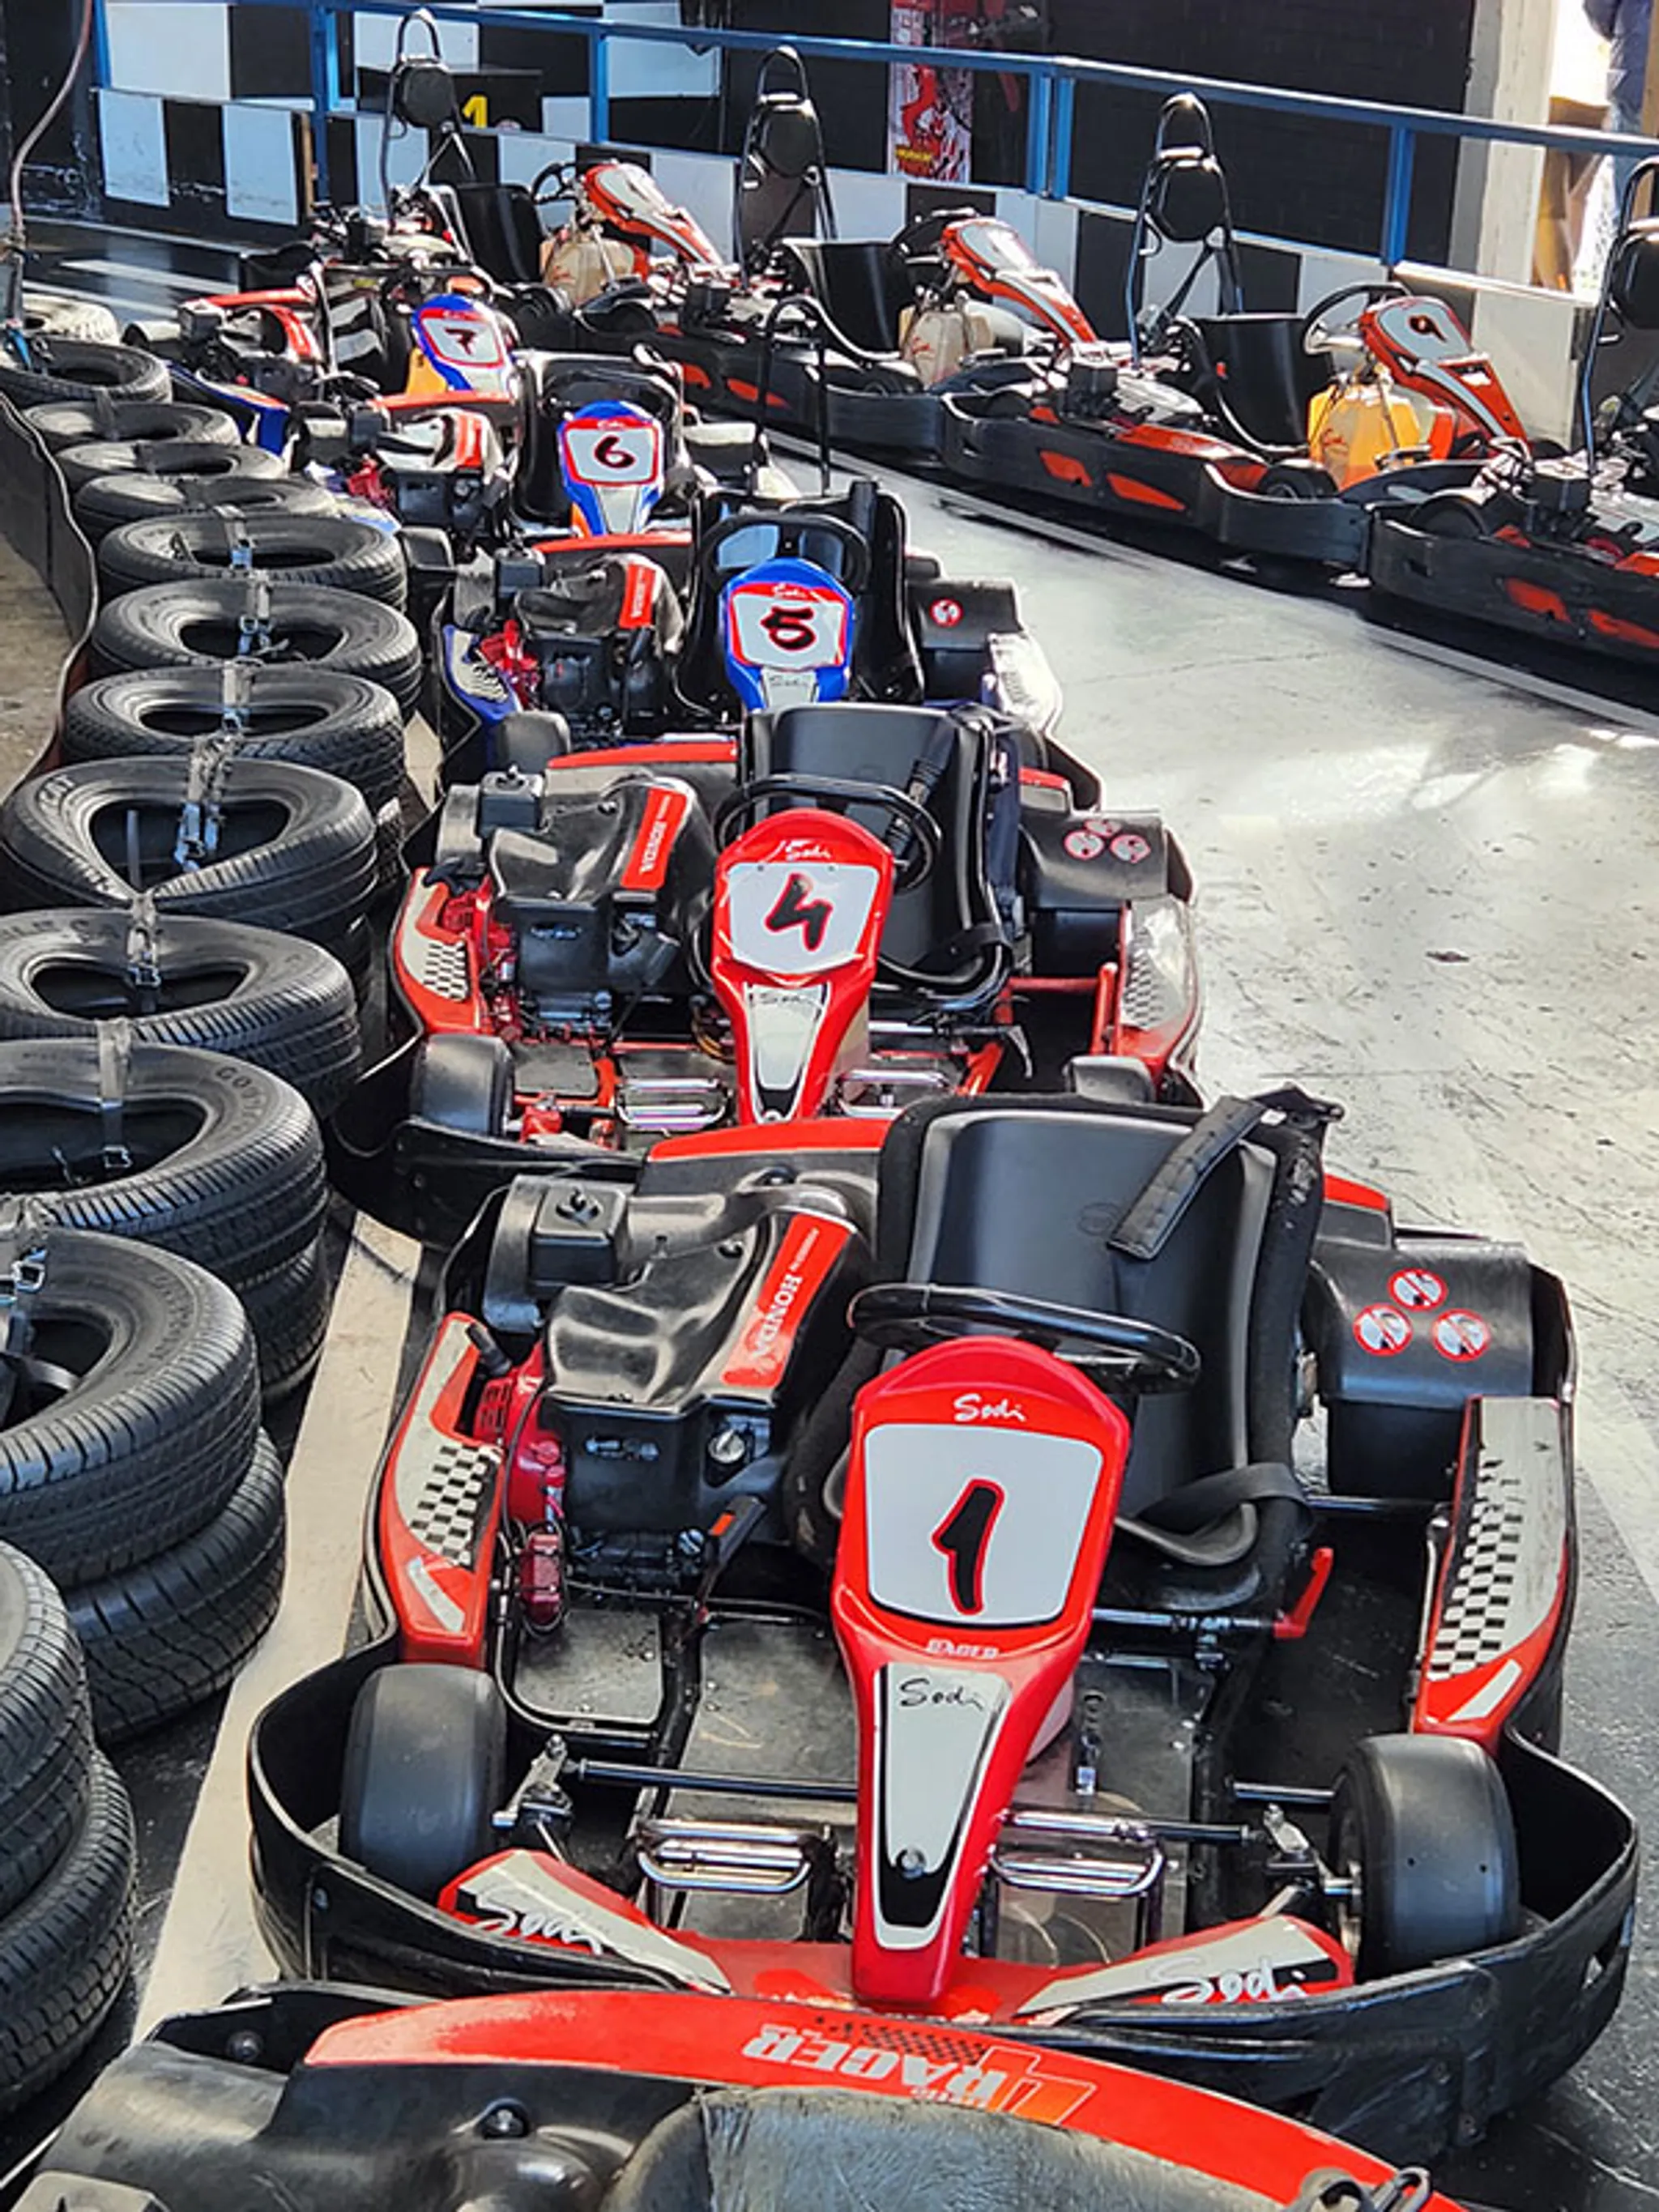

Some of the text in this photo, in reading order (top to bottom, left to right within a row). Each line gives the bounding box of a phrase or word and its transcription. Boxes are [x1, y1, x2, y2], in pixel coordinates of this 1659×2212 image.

[593, 434, 636, 469] 6
[759, 605, 817, 652] 5
[764, 872, 834, 953] 4
[953, 1392, 1027, 1423] Sodi
[931, 1478, 1005, 1616] 1
[899, 1677, 984, 1711] Sodi
